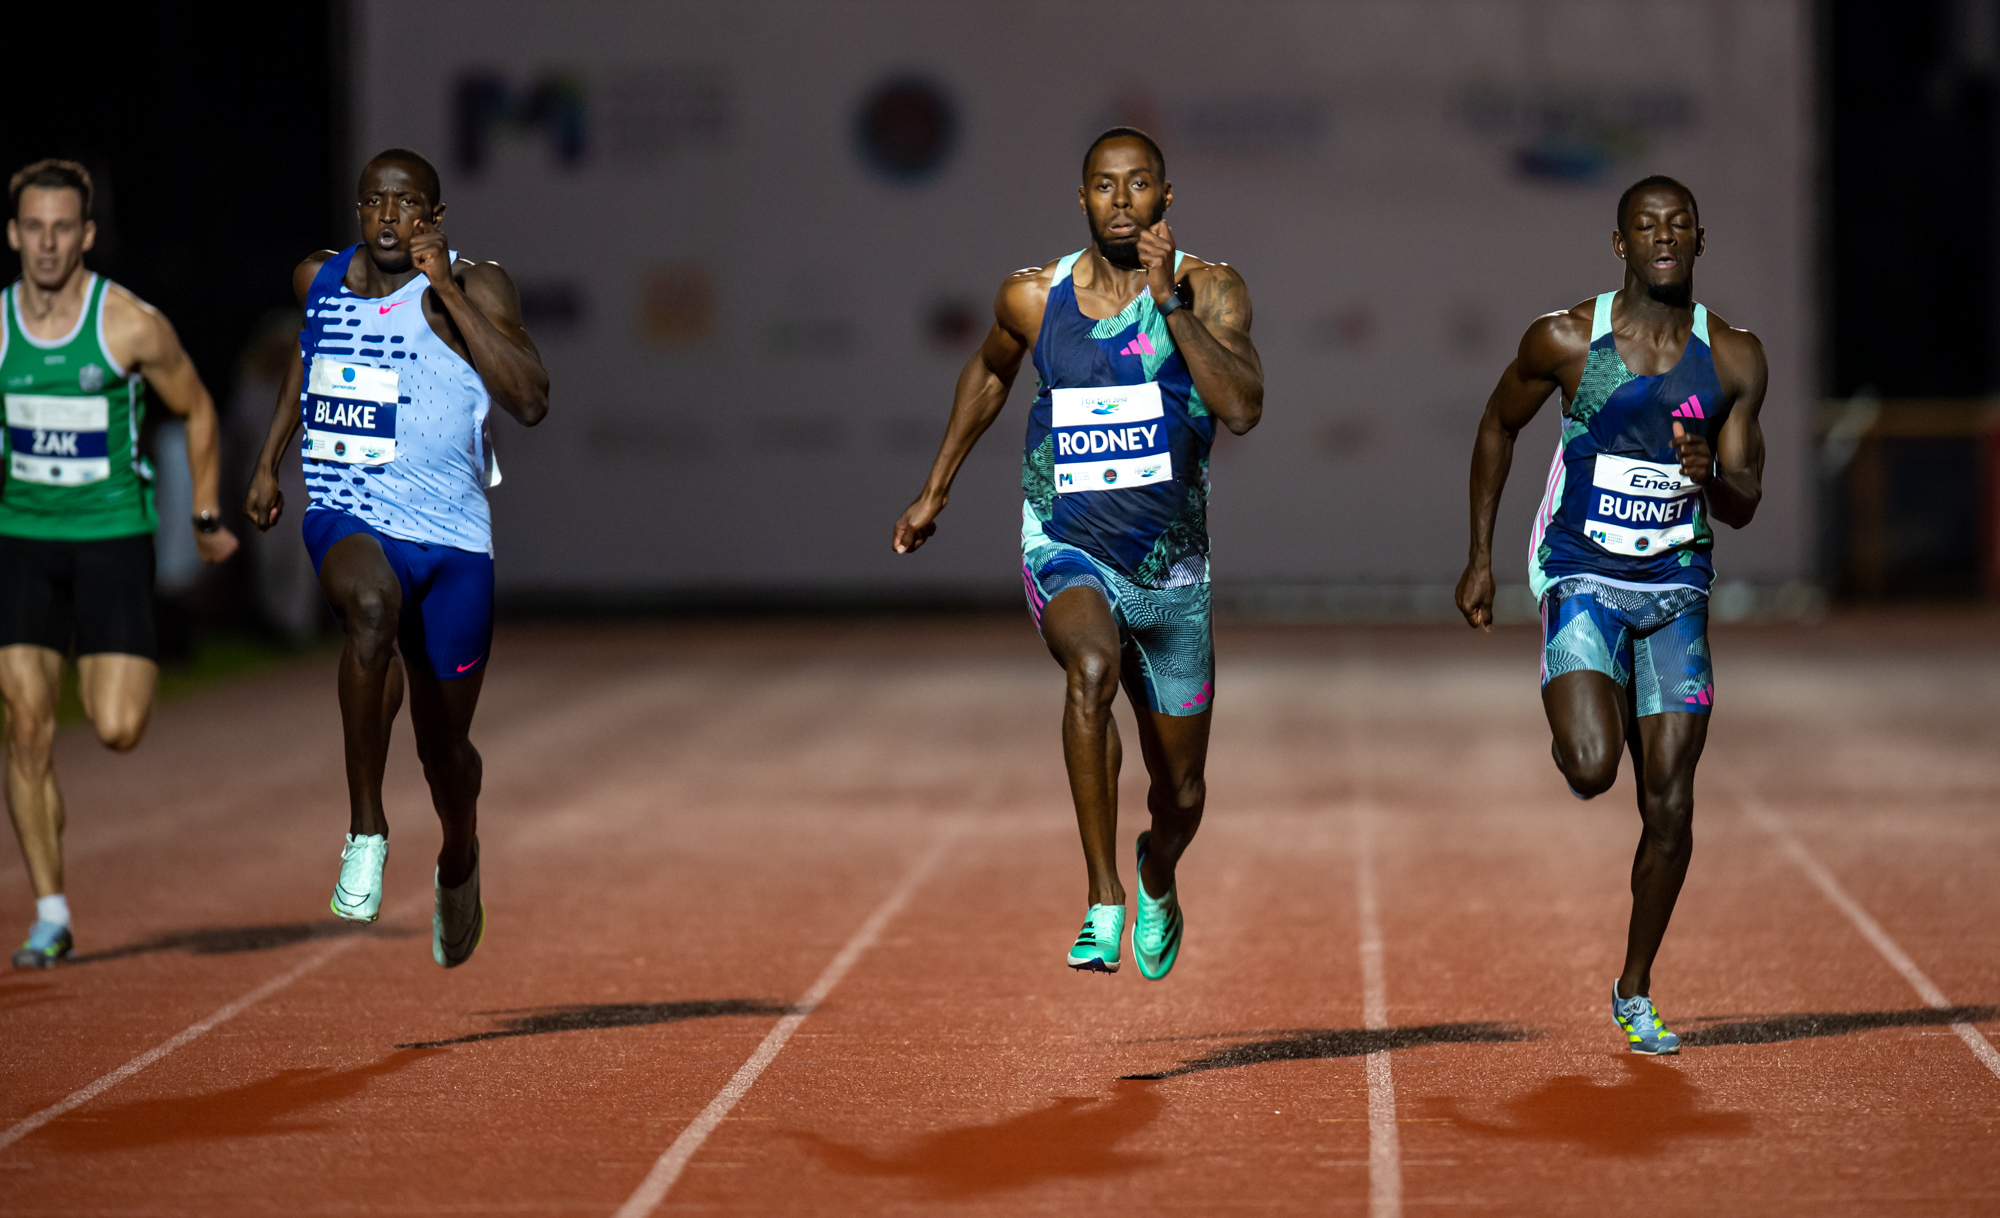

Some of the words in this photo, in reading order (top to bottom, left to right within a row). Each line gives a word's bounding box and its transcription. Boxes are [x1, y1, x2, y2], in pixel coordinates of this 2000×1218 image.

[314, 400, 377, 429] BLAKE
[1058, 424, 1158, 455] RODNEY
[1630, 474, 1682, 490] Enea
[1598, 493, 1688, 523] BURNET
